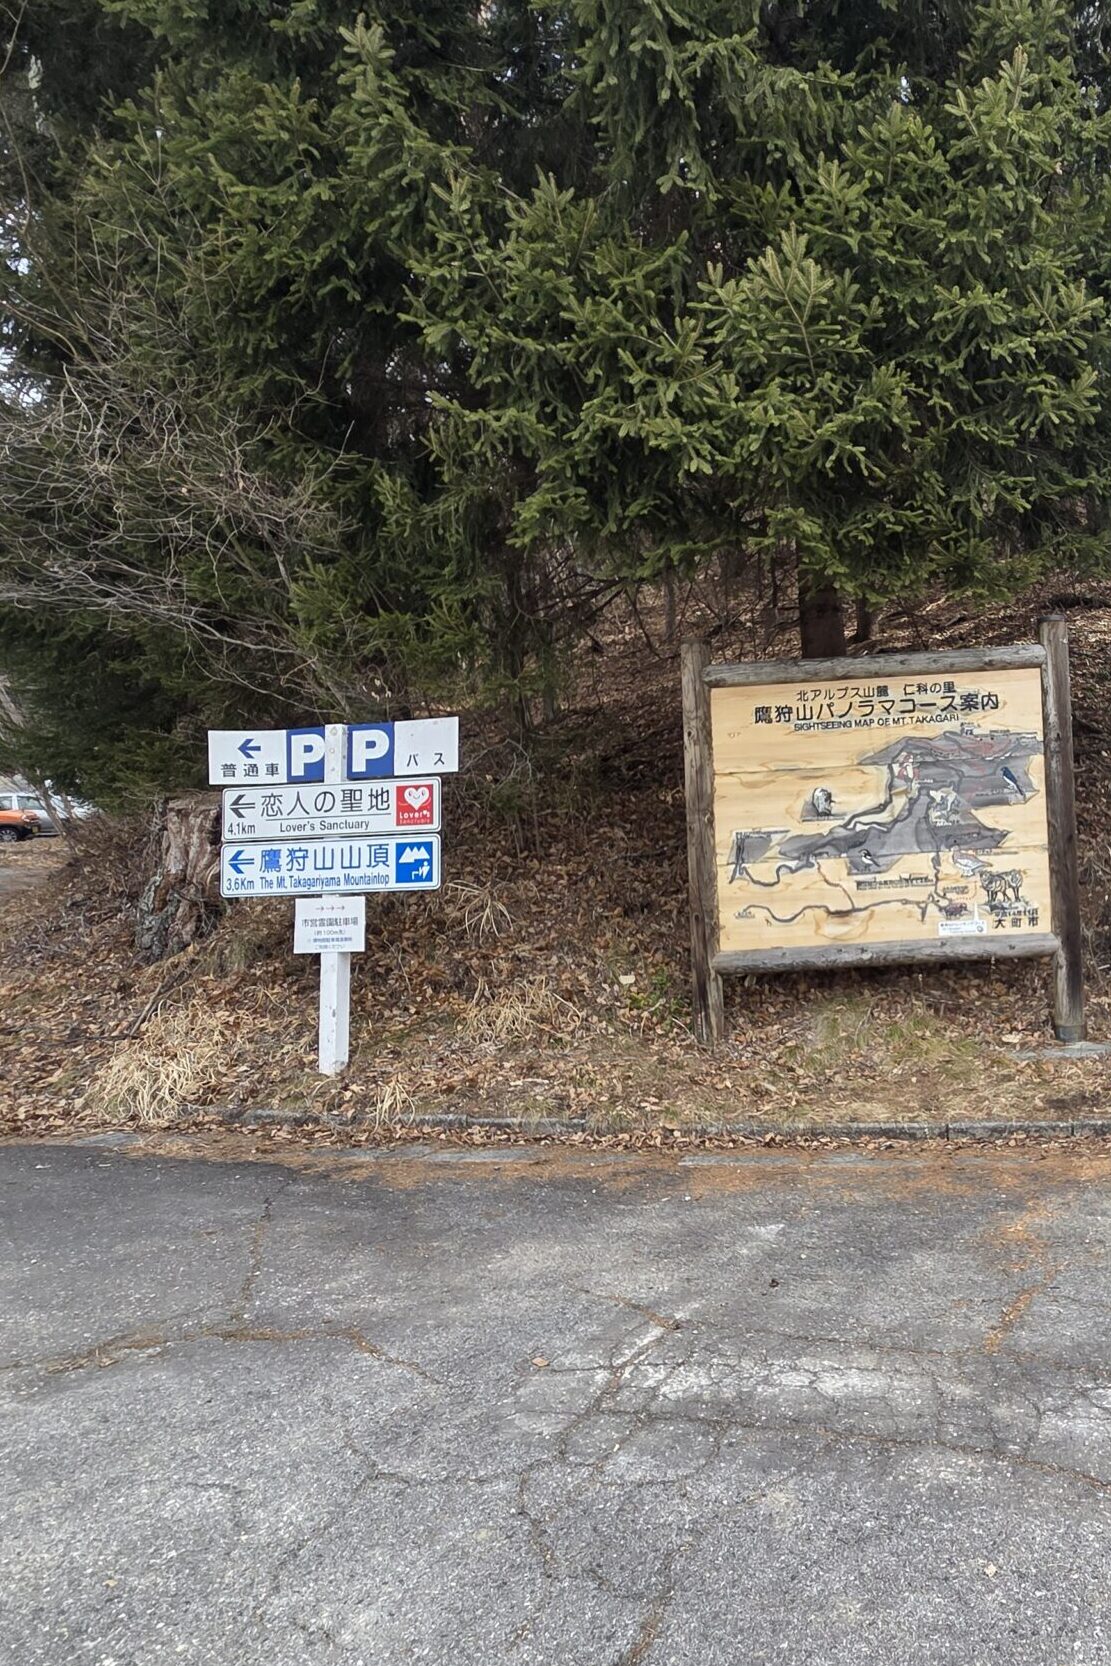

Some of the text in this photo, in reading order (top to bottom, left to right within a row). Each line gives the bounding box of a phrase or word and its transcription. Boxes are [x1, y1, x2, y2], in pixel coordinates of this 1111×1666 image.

[796, 681, 956, 701] 北アルプス山麓 仁科の里
[754, 691, 999, 724] 鷹狩山パノラマコース案内
[794, 720, 852, 732] SIGHTSEEING
[854, 718, 875, 728] MAP
[291, 733, 325, 777] P
[351, 729, 390, 773] P
[406, 752, 445, 767] バス
[220, 762, 280, 778] 普通車
[260, 786, 390, 817] 恋人の聖地
[227, 821, 256, 836] 4.1km
[279, 819, 370, 833] Lover's Sanctuary
[259, 843, 390, 873] 鷹狩山山頂
[226, 877, 255, 892] 3.6Km
[259, 876, 274, 890] The
[289, 872, 341, 890] Takagariyama
[343, 872, 390, 886] Mountaintop
[993, 915, 1039, 929] 大町市
